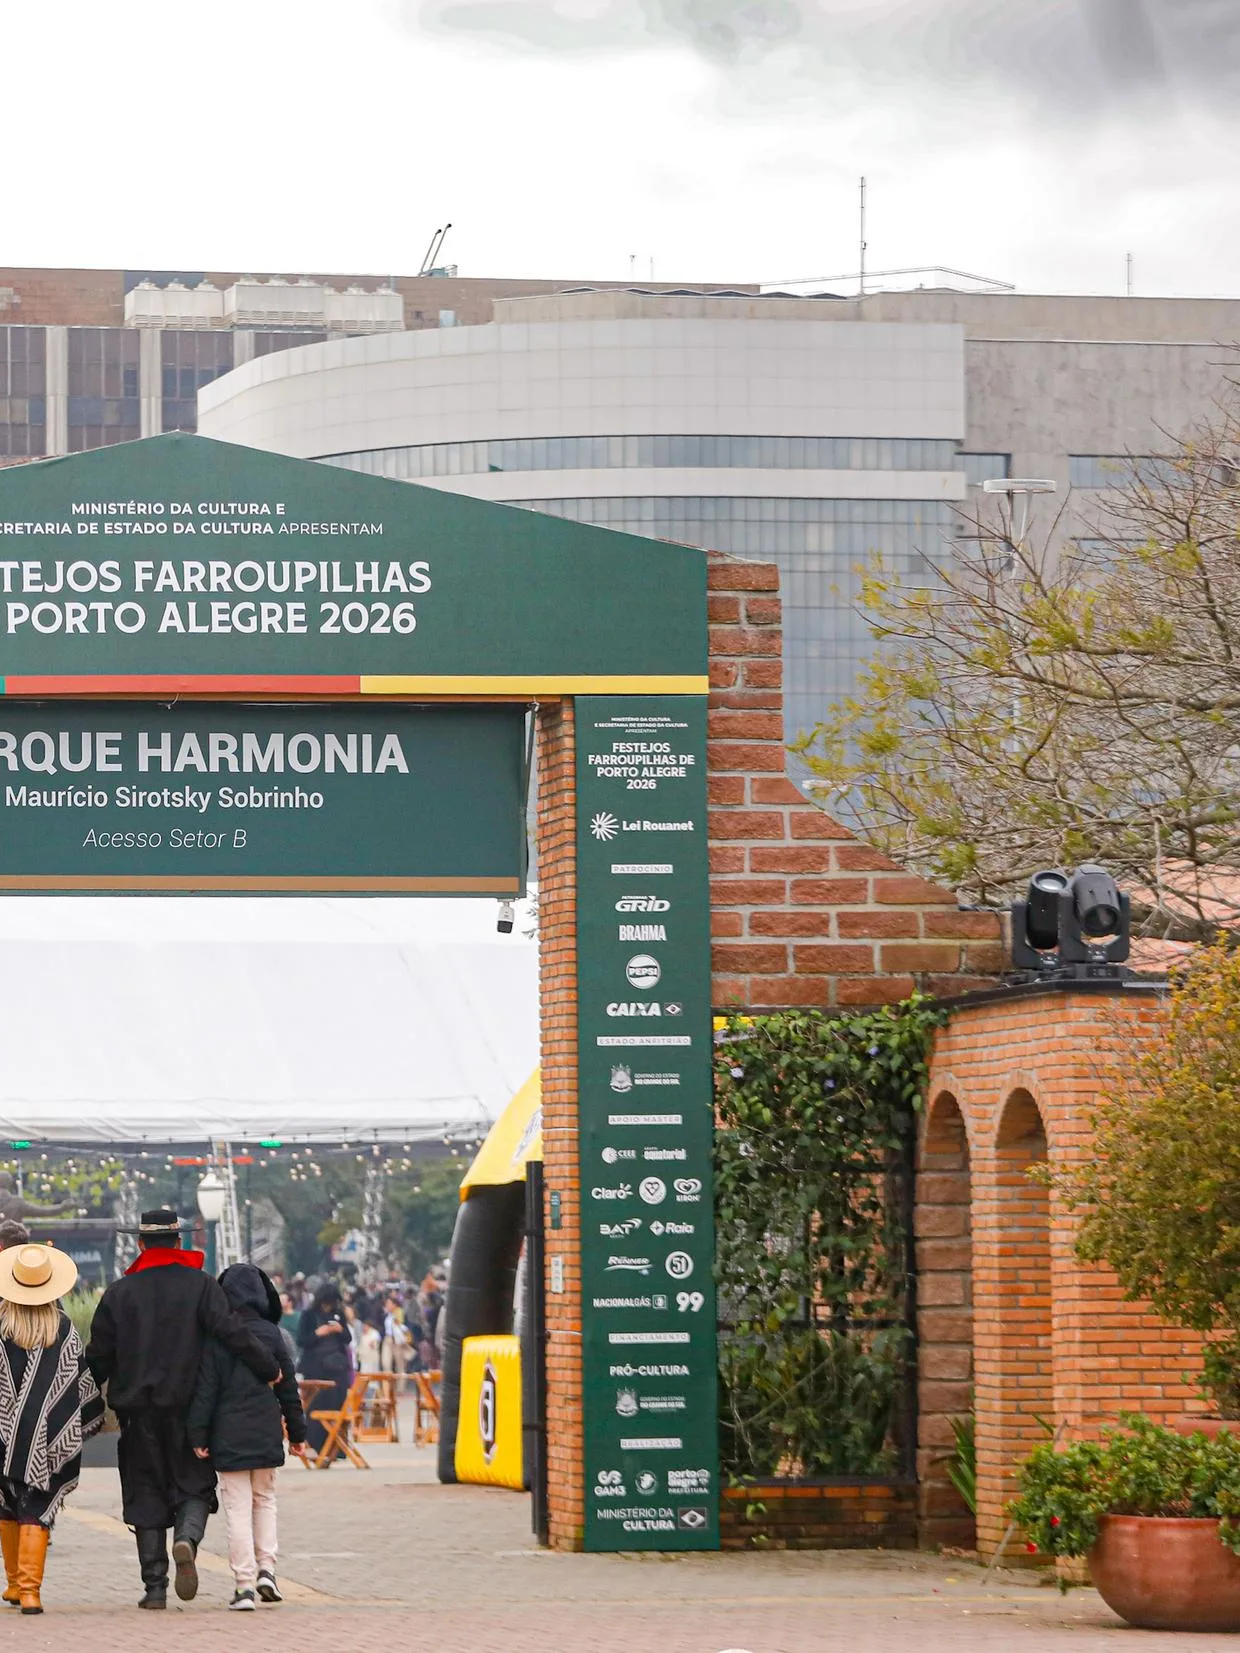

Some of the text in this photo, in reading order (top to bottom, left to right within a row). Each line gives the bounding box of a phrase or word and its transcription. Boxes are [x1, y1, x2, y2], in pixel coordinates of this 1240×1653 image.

[71, 501, 286, 516] MINISTÉRIO DA CULTURA E
[78, 522, 99, 535] DE
[104, 522, 169, 535] ESTADO
[173, 522, 196, 535] DA
[201, 522, 274, 535] CULTURA
[278, 522, 384, 535] APRESENTAM
[134, 561, 433, 593] FARROUPILHAS
[6, 602, 146, 634] PORTO
[158, 602, 308, 634] ALEGRE
[320, 602, 417, 634] 2026
[138, 732, 410, 775] HARMONIA
[612, 742, 670, 753] FESTEJOS
[588, 755, 695, 765] FARROUPILHAS DE
[597, 767, 686, 777] PORTO ALEGRE
[626, 780, 656, 789] 2026
[5, 785, 324, 813] Maurício Sirotsky Sobrinho
[622, 821, 694, 831] Lei Rouanet
[82, 828, 247, 849] Acesso Setor B
[619, 925, 667, 941] BRAHMA
[606, 1003, 661, 1016] CAIXA
[591, 1188, 627, 1200] Claro
[666, 1222, 695, 1234] Raia
[672, 1258, 686, 1272] 51
[676, 1292, 704, 1312] 99
[609, 1363, 690, 1377] PRÓ-CULTURA
[597, 1506, 674, 1519] MINISTÉRIO DA
[623, 1520, 675, 1531] CULTURA
